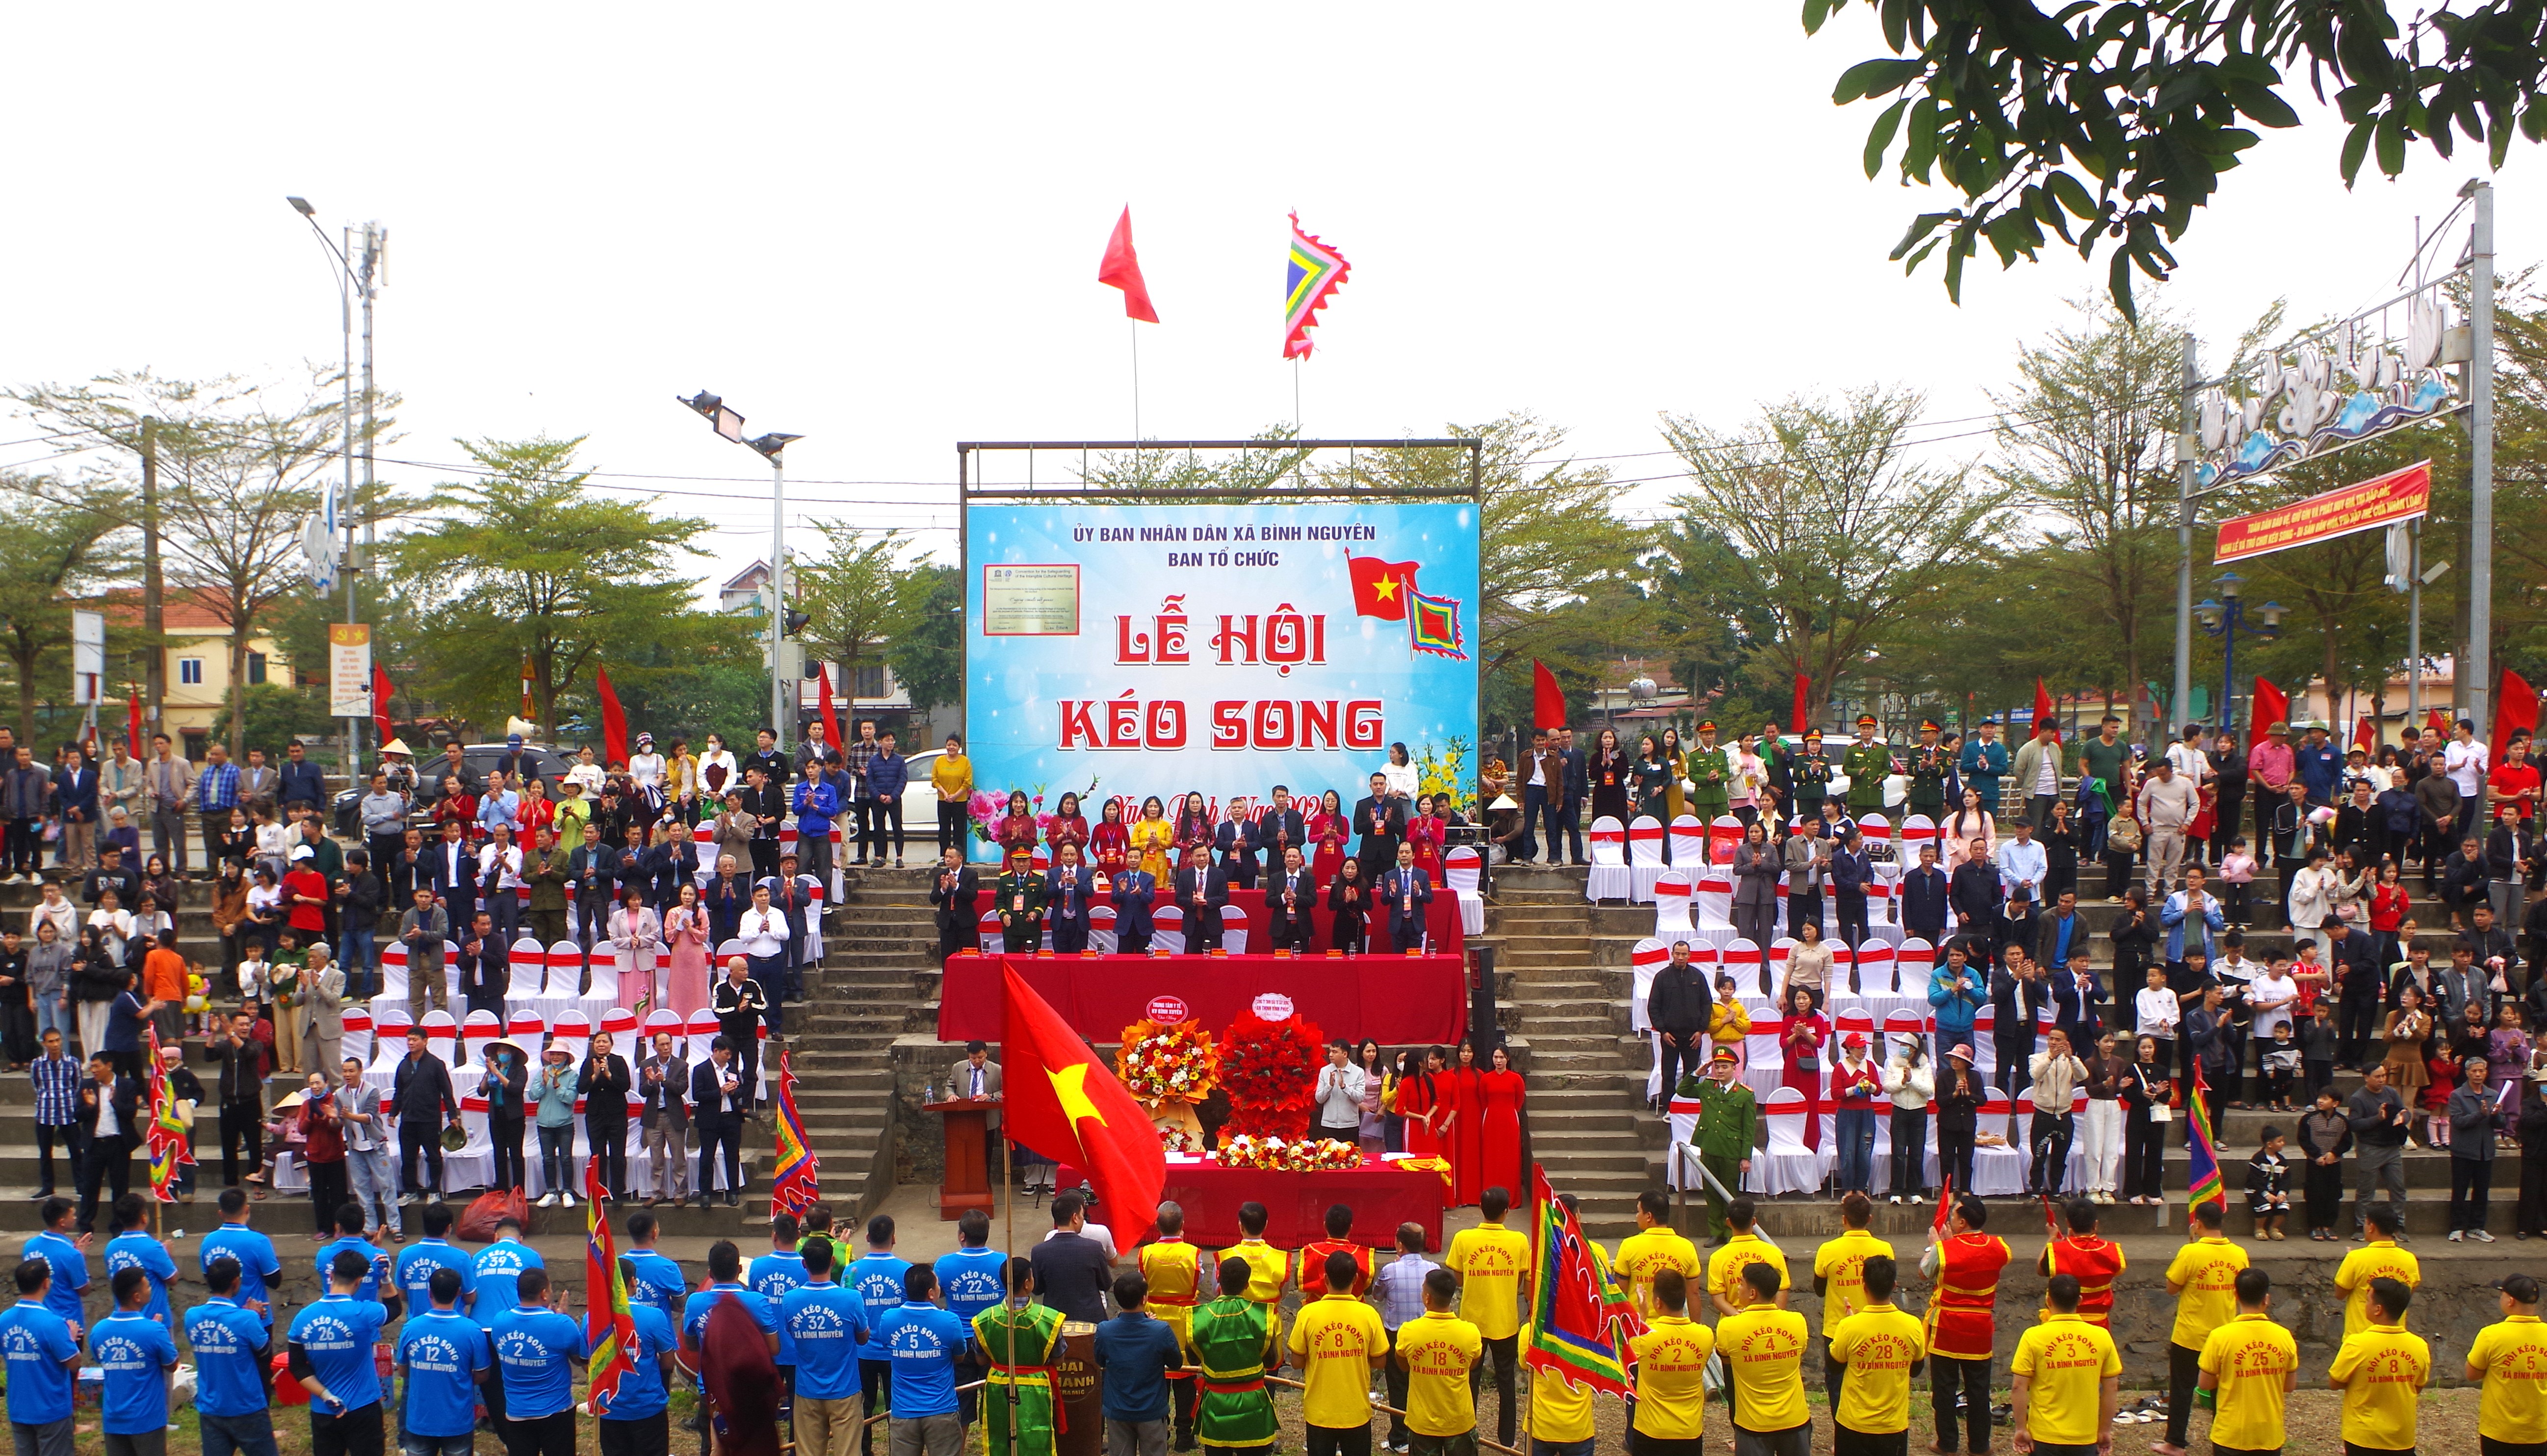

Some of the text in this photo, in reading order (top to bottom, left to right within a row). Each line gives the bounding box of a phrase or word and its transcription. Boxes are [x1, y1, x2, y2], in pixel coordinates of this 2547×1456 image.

[1073, 523, 1375, 542] ỦY BAN NHÂN DÂN XÃ BÌNH NGUYÊN
[1168, 546, 1279, 567] BAN TỔ CHỨC
[1114, 593, 1326, 677] LỄ HỘI
[1057, 689, 1384, 751] KÉO SONG
[1112, 795, 1144, 825] Xu
[1285, 795, 1323, 825] 202
[489, 1256, 507, 1268] 39
[1468, 1244, 1514, 1266] ĐỘI KÉO SONG
[1486, 1255, 1494, 1267] 4
[1636, 1251, 1683, 1273] ĐỘI KÉO SONG
[865, 1273, 902, 1295] KÉO SONG
[950, 1270, 1000, 1292] ĐỘI KÉO SONG
[2217, 1271, 2224, 1282] 3
[773, 1282, 785, 1296] 18
[872, 1284, 884, 1297] 19
[966, 1280, 983, 1294] 22
[792, 1303, 843, 1329] ĐỘI KÉO SONG
[807, 1316, 826, 1330] 32
[202, 1330, 220, 1345] 34
[318, 1327, 335, 1341] 26
[794, 1329, 844, 1339] XÃ BÌNH NGUYÊN
[890, 1323, 941, 1347] ĐỘI KÉO SONG
[910, 1334, 919, 1349] 5
[1314, 1321, 1364, 1347] ĐỘI KÉO SONG
[1334, 1334, 1343, 1348] 8
[1741, 1326, 1798, 1352] ĐỘI KÉO SONG
[14, 1337, 25, 1352] 21
[409, 1334, 459, 1361] ĐỘI KÉO SONG
[514, 1342, 524, 1357] 2
[1413, 1339, 1466, 1364] ĐỘI KÉO SONG
[1649, 1336, 1703, 1360] ĐỘI KÉO SONG
[1766, 1337, 1775, 1351] 4
[1856, 1332, 1910, 1357] ĐỘI KÉO SONG
[2045, 1332, 2097, 1357] ĐỘI KÉO SONG
[2066, 1344, 2076, 1357] 3
[111, 1347, 127, 1361] 28
[426, 1347, 441, 1362] 12
[1433, 1352, 1446, 1366] 18
[1673, 1349, 1681, 1363] 2
[1875, 1345, 1893, 1359] 28
[2234, 1340, 2284, 1365] ĐỘI KÉO SONG
[2252, 1352, 2268, 1366] 25
[2503, 1343, 2536, 1367] ĐỘI KÉO
[1649, 1362, 1701, 1372] XÃ BÌNH NGUYÊN
[2057, 1360, 2072, 1368] BÌNH
[2074, 1358, 2097, 1367] NGUYÊN
[2367, 1348, 2418, 1373] ĐỘI KÉO SONG
[2390, 1359, 2398, 1373] 8
[2527, 1356, 2535, 1370] 5
[1058, 1376, 1094, 1387] ANH
